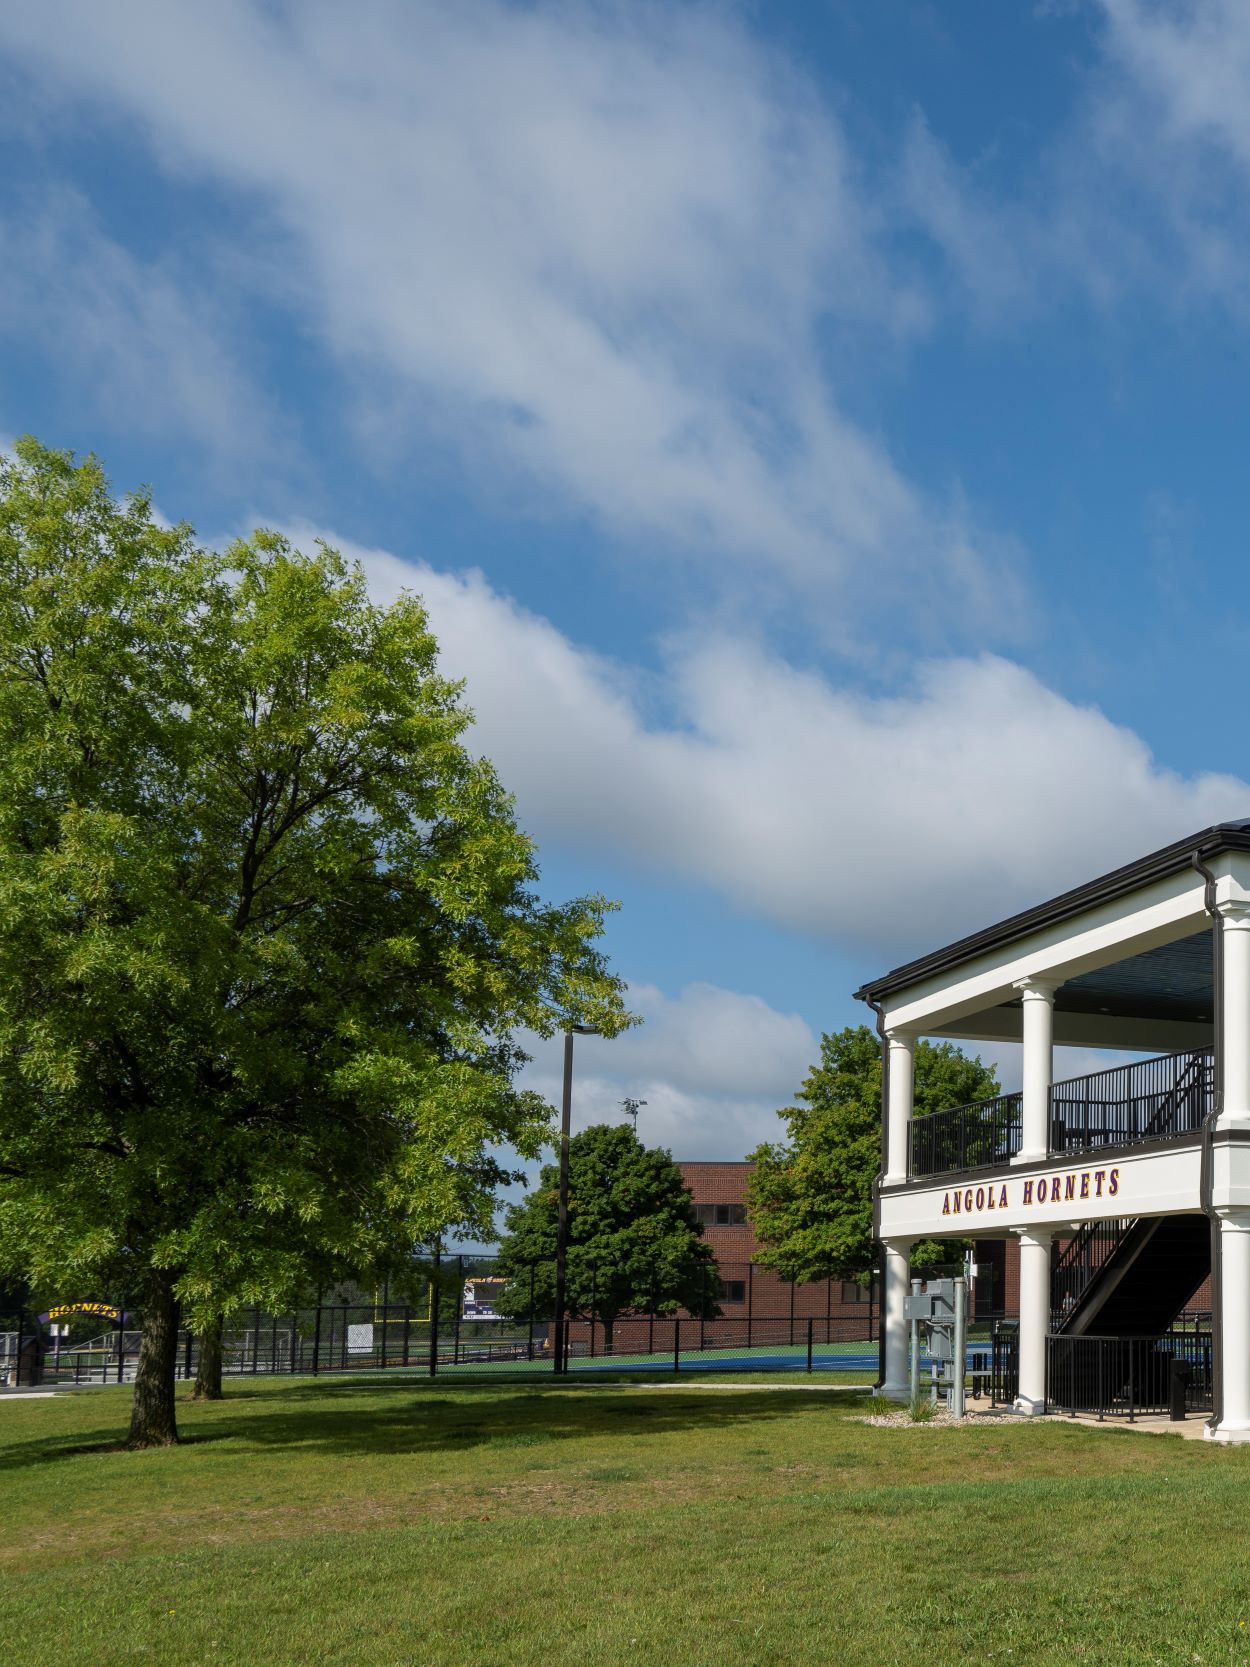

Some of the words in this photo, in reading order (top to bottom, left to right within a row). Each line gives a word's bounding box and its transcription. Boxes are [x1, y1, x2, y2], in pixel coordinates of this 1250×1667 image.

[942, 1184, 1008, 1215] ANGOLA
[1023, 1168, 1120, 1205] HORNETS
[48, 1303, 119, 1319] HORNETS
